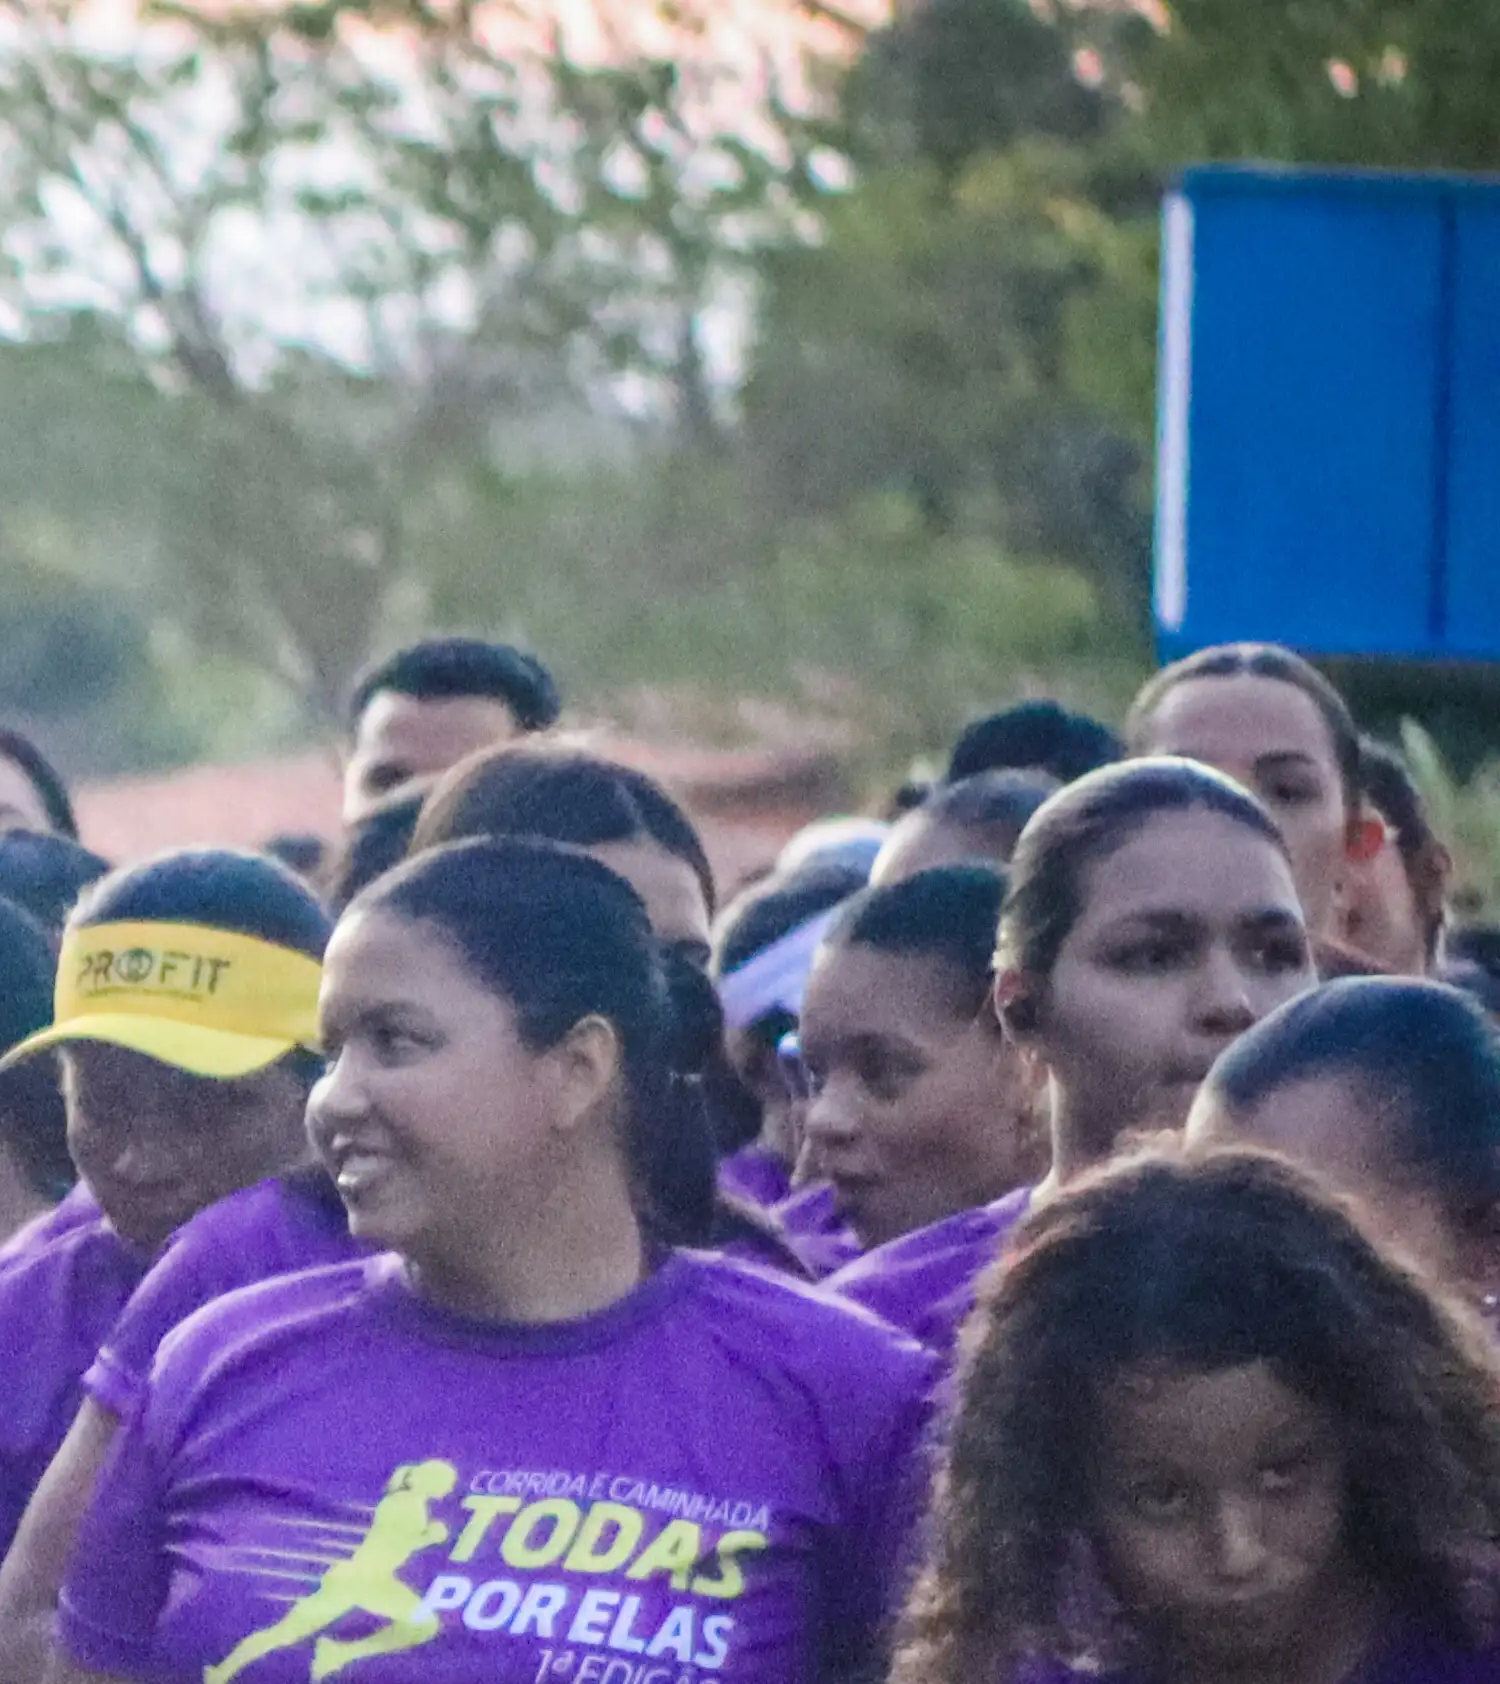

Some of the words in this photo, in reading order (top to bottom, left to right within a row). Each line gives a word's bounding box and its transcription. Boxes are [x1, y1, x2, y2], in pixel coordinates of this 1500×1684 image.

[449, 1493, 768, 1600] TODAS
[470, 1470, 586, 1498] CORRIDA
[608, 1475, 771, 1532] CAMINHADA
[414, 1574, 568, 1638] POR
[567, 1589, 735, 1670] ELAS
